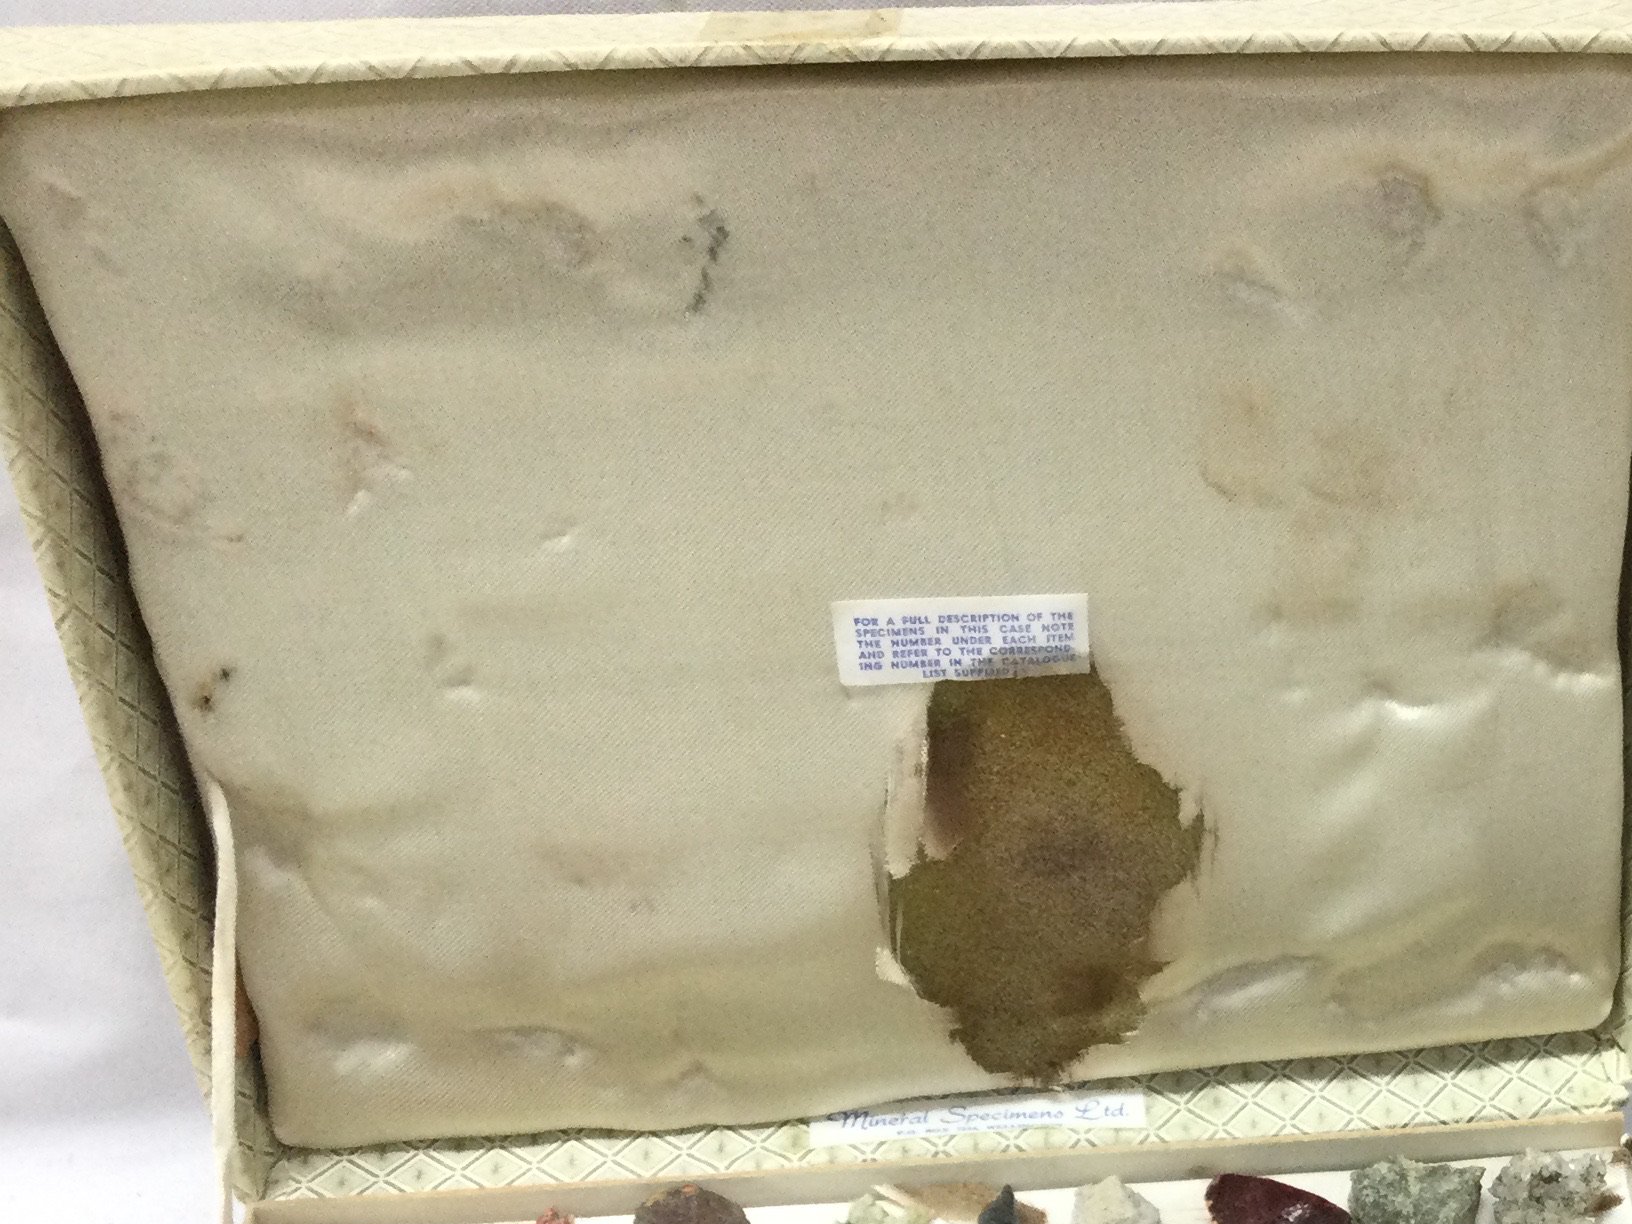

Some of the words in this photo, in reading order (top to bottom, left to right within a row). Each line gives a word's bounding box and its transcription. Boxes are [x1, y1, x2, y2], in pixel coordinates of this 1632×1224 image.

[853, 616, 879, 626] FOR
[886, 617, 895, 626] A
[901, 615, 931, 625] FULL
[938, 613, 1020, 624] DESCRIPTION
[1027, 613, 1043, 622] OF
[1050, 612, 1073, 621] THE
[855, 627, 925, 638] SPECIMENS
[936, 625, 949, 635] IN
[961, 625, 988, 634] THIS
[999, 624, 1032, 634] CASE
[1041, 623, 1074, 632] NOTE
[857, 640, 881, 649] THE
[891, 638, 942, 648] NUMBER
[952, 636, 992, 645] UNDER
[1002, 634, 1036, 644] EACH
[1046, 633, 1074, 643] ITEM
[858, 650, 884, 660] AND
[892, 649, 928, 659] REFER
[935, 648, 951, 657] TO
[960, 647, 983, 657] THE
[859, 661, 883, 671] ING
[891, 659, 941, 670] NUMBER
[949, 657, 962, 667] IN
[970, 657, 994, 667] THE
[1001, 654, 1077, 667] CATALOGUE
[922, 669, 947, 678] LIST
[826, 1109, 929, 1130] Mineral
[940, 1105, 1064, 1126] Specimens
